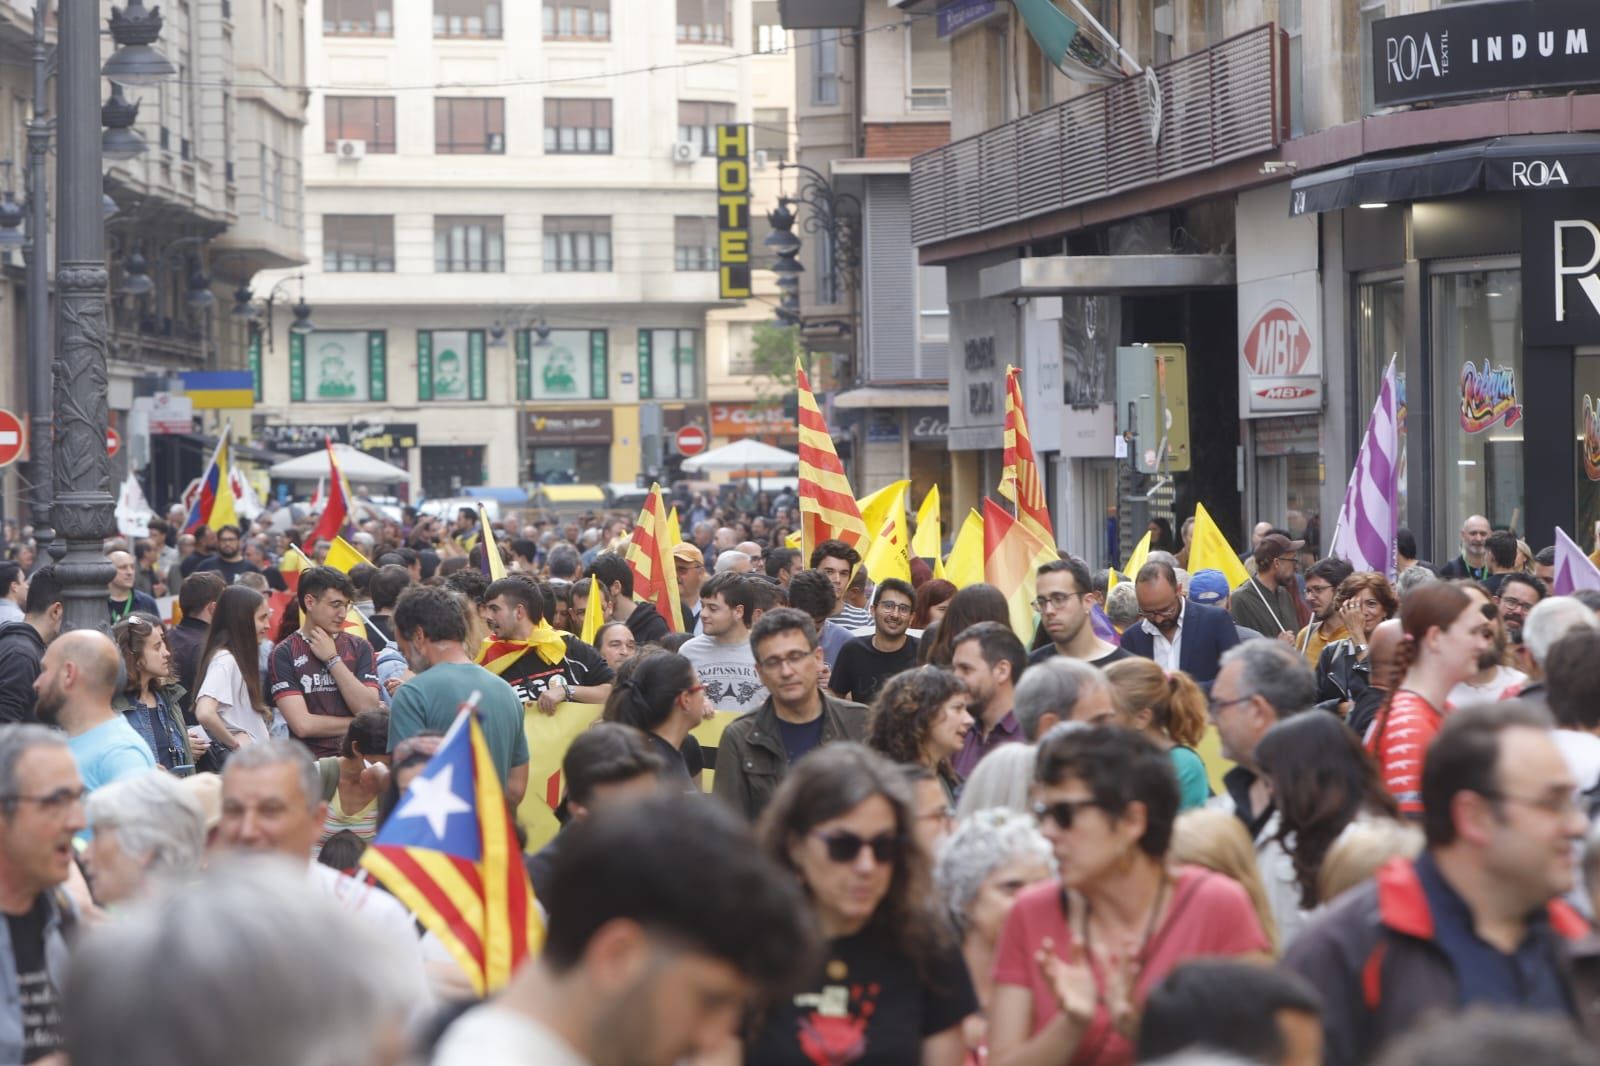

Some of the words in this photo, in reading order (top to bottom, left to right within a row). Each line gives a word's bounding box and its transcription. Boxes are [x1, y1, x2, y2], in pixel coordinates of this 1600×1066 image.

[1387, 32, 1441, 84] ROA
[1441, 29, 1449, 77] TEXTIL
[1472, 28, 1588, 64] INDUM
[1512, 160, 1569, 187] ROA
[717, 125, 749, 298] HOTEL
[1254, 319, 1301, 375] MBT
[1265, 386, 1304, 399] MBT
